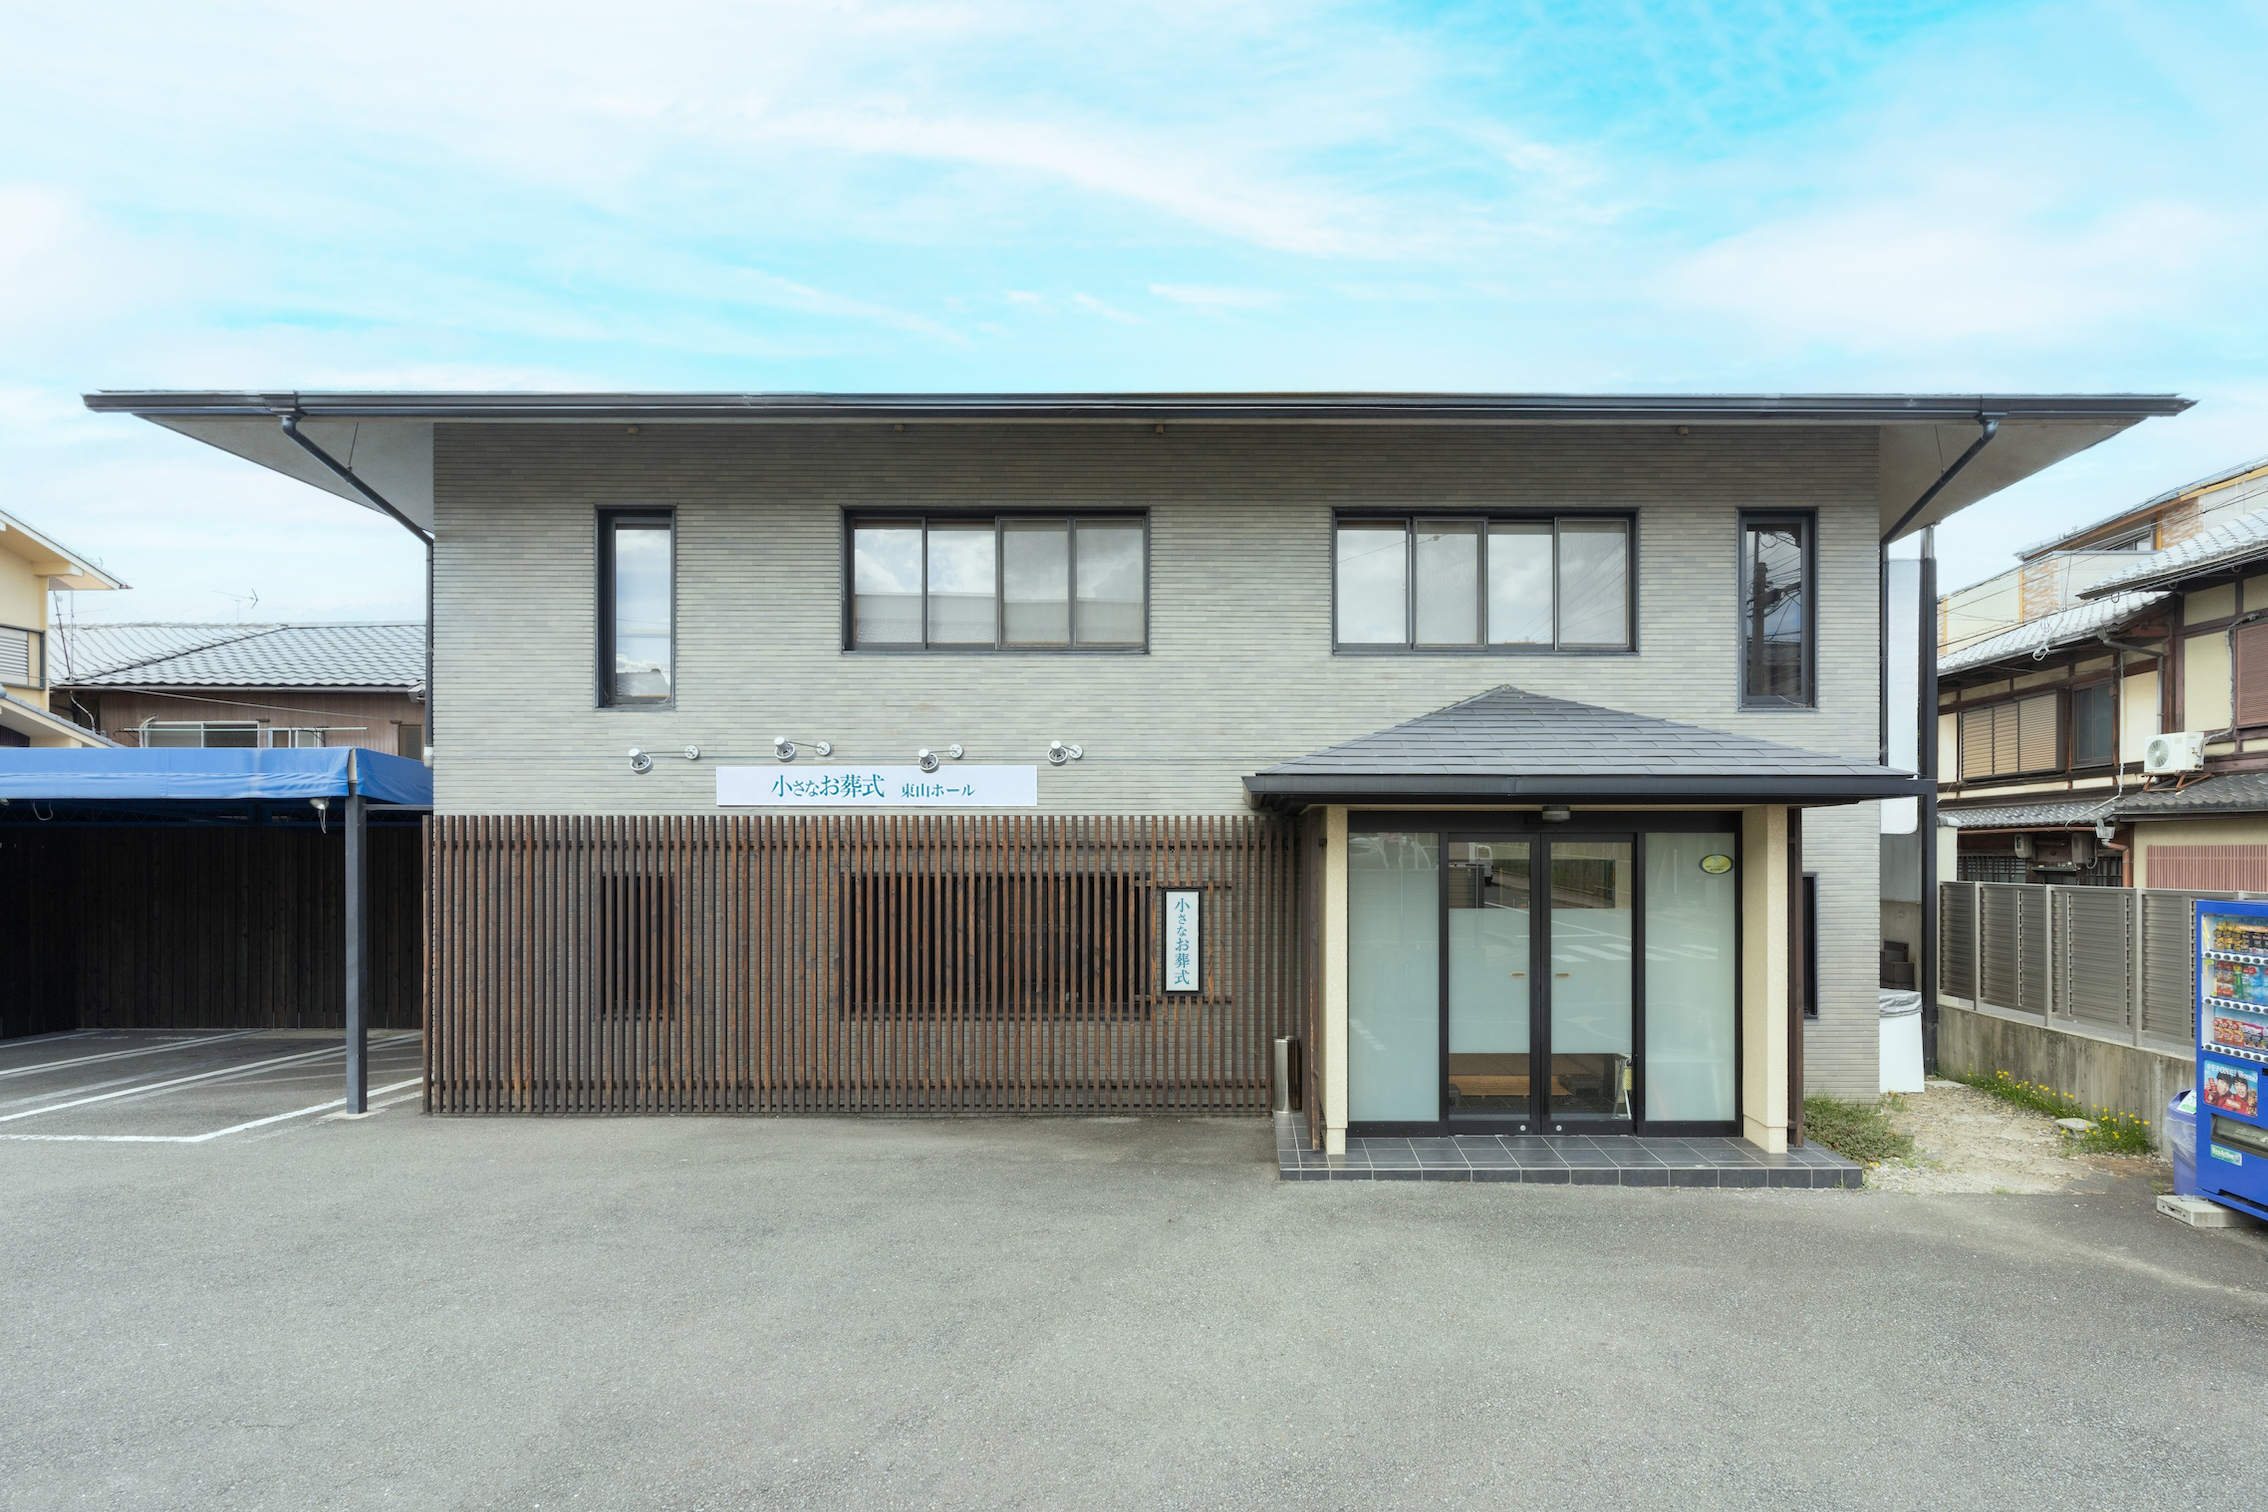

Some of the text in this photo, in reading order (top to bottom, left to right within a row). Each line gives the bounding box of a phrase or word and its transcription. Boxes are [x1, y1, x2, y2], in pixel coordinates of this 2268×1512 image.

[770, 773, 976, 799] 小さなお葬式 東山ホール
[1174, 897, 1191, 986] 小さなお葬式
